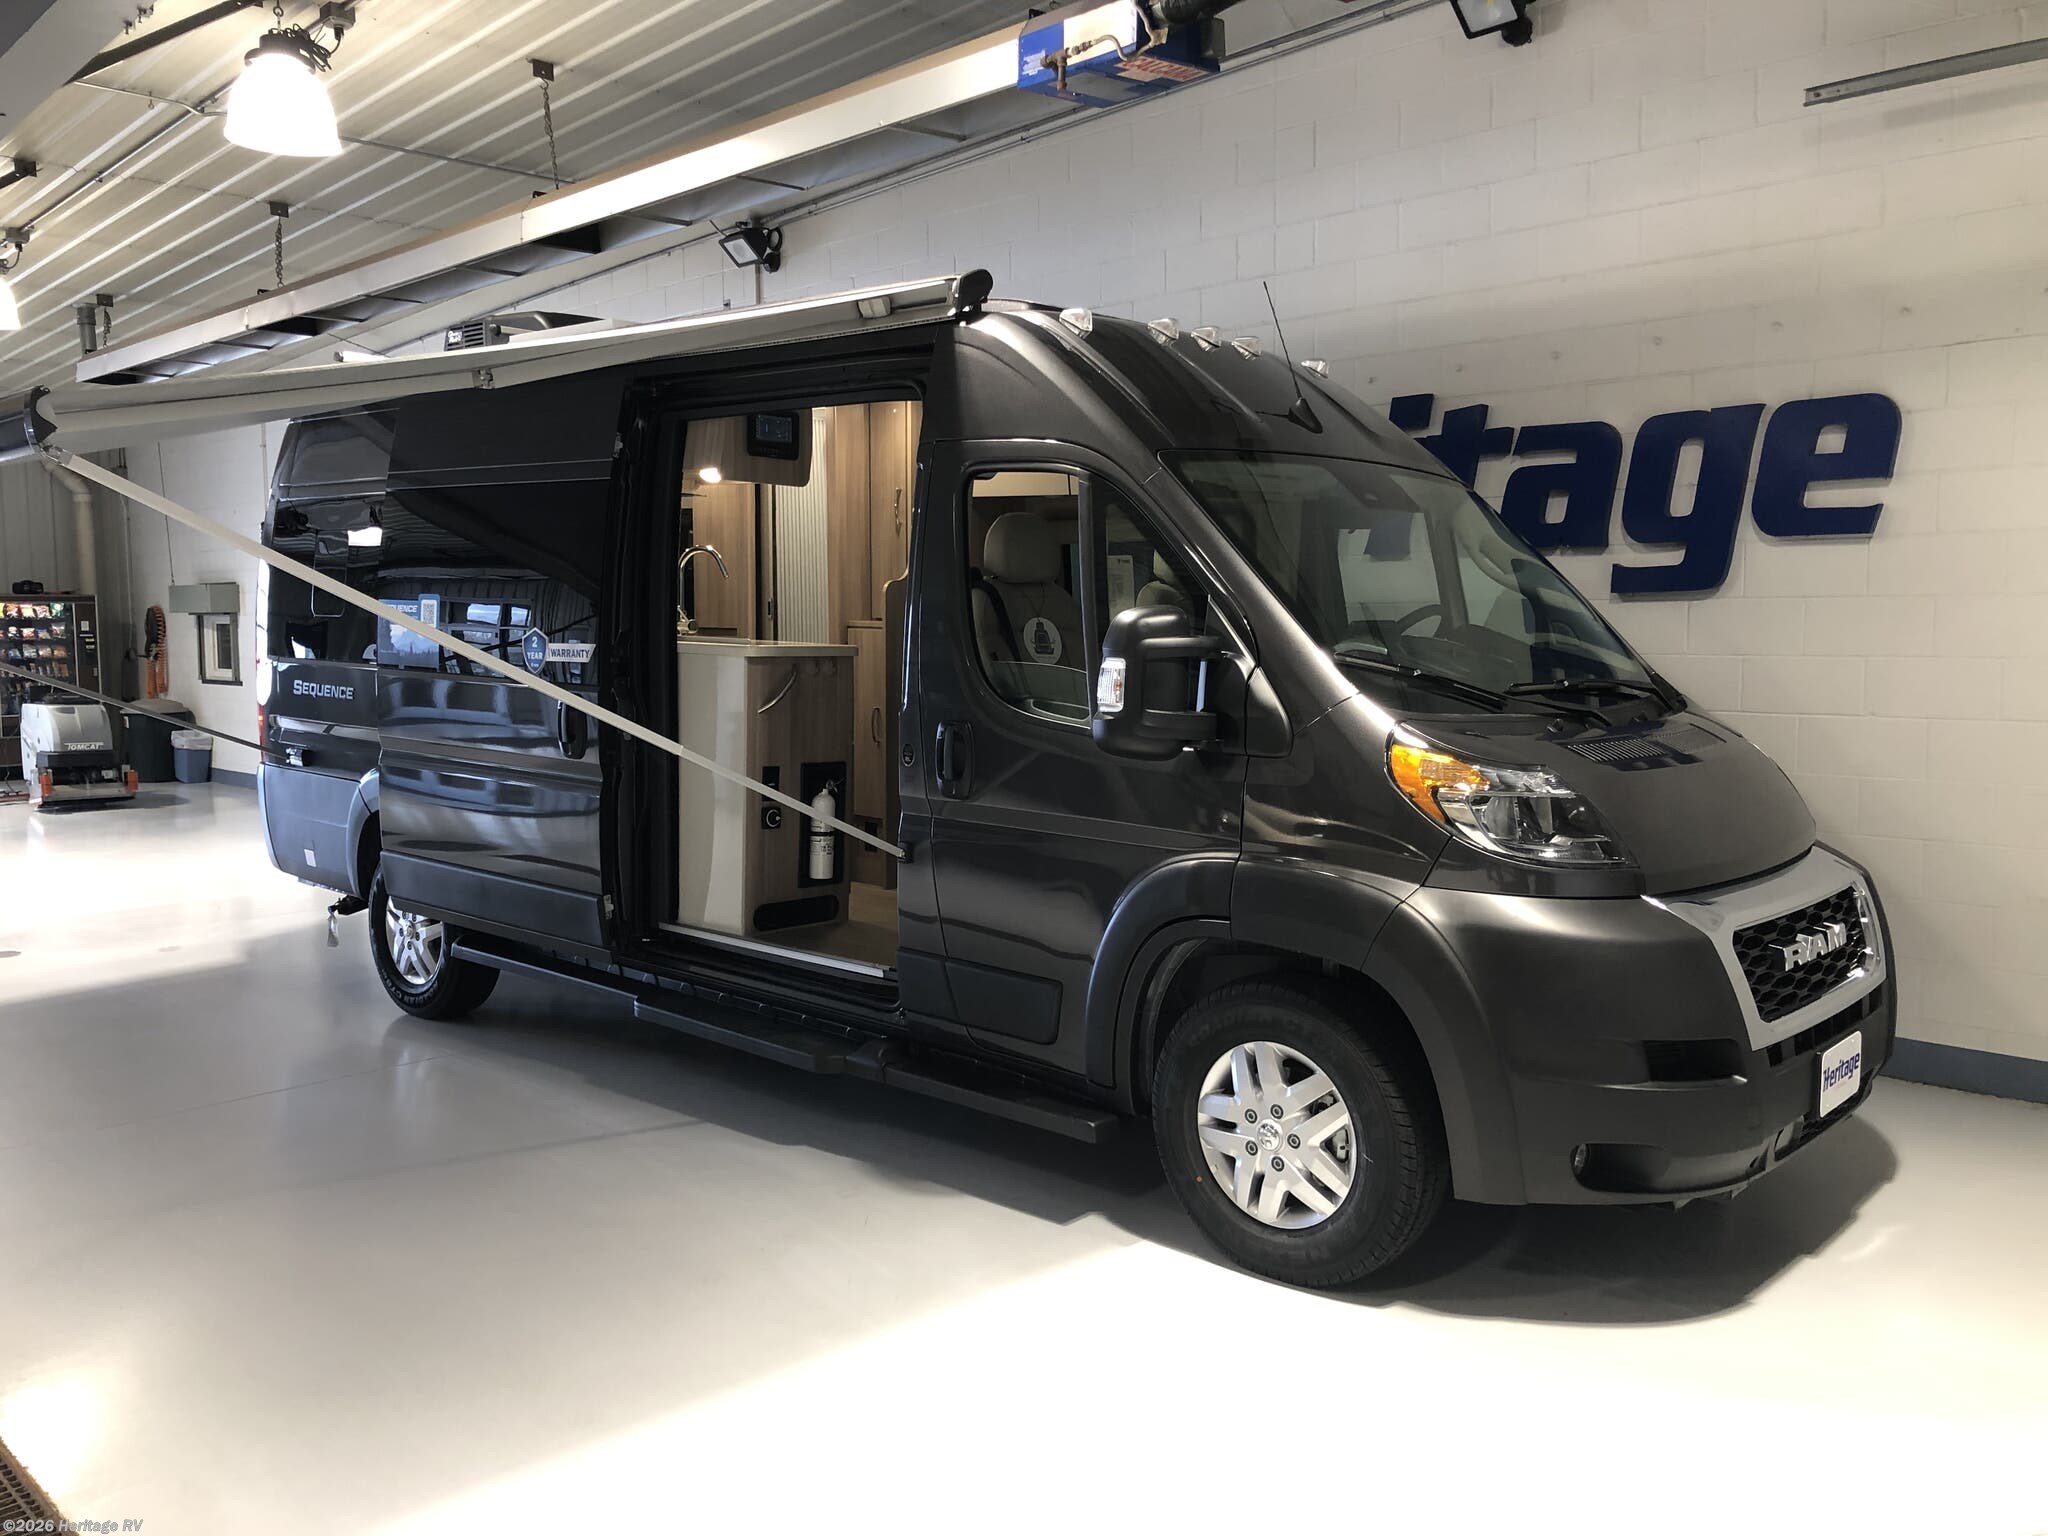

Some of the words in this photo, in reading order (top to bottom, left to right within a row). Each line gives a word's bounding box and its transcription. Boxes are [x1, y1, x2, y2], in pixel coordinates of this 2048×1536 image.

[1389, 392, 1902, 594] tage
[531, 636, 538, 648] 2
[527, 652, 543, 660] YEAR
[550, 648, 590, 659] WARRANTY
[63, 741, 104, 751] TOMCAT
[1782, 921, 1848, 972] RAM
[1823, 1052, 1860, 1092] Heritage
